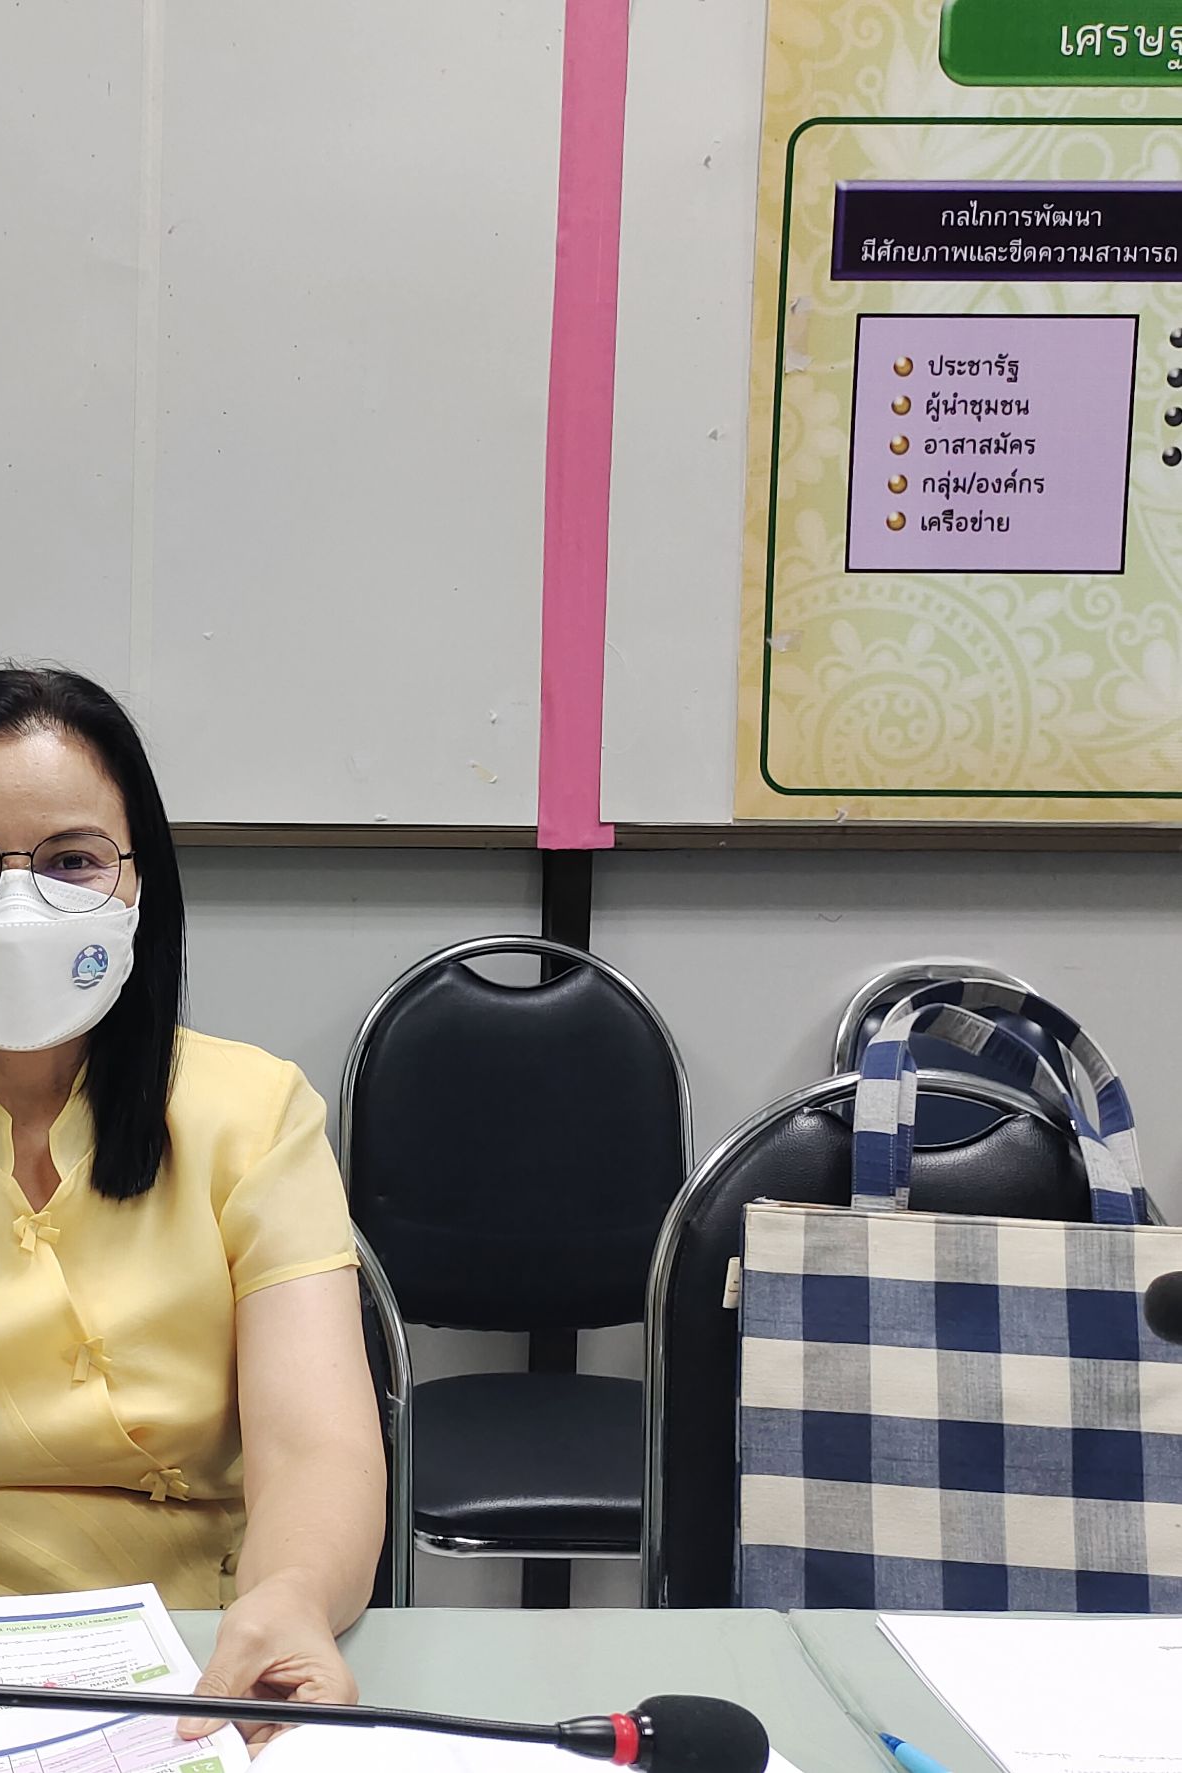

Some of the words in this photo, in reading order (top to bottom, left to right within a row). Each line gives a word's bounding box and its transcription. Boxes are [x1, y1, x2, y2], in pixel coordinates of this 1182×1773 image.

[940, 199, 1102, 228] กลไกการพัฒนา
[860, 237, 1178, 264] มีศักยภาพและขีดความสามารถ
[927, 352, 1019, 383] ประชารัฐ
[924, 391, 1030, 423] ผู้นำชุมชน
[923, 430, 1036, 456] อาสาสมัคร
[921, 468, 1045, 501] กลุ่ม/องค์กร
[919, 508, 1010, 533] เครือข่าย
